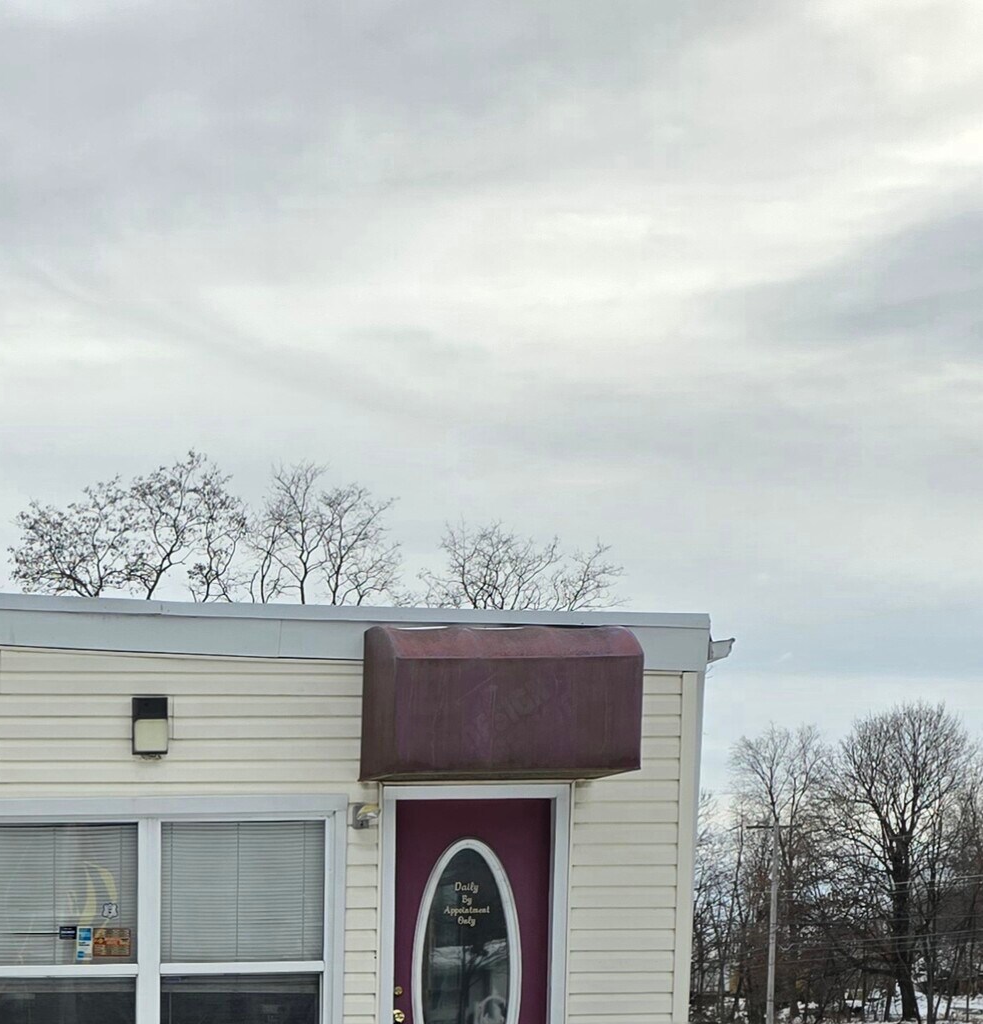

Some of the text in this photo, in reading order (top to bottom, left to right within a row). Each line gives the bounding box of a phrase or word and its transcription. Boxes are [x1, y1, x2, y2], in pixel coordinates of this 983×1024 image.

[454, 881, 479, 894] Daily
[461, 894, 473, 906] By
[443, 905, 491, 917] Appointment
[457, 915, 476, 927] Only
